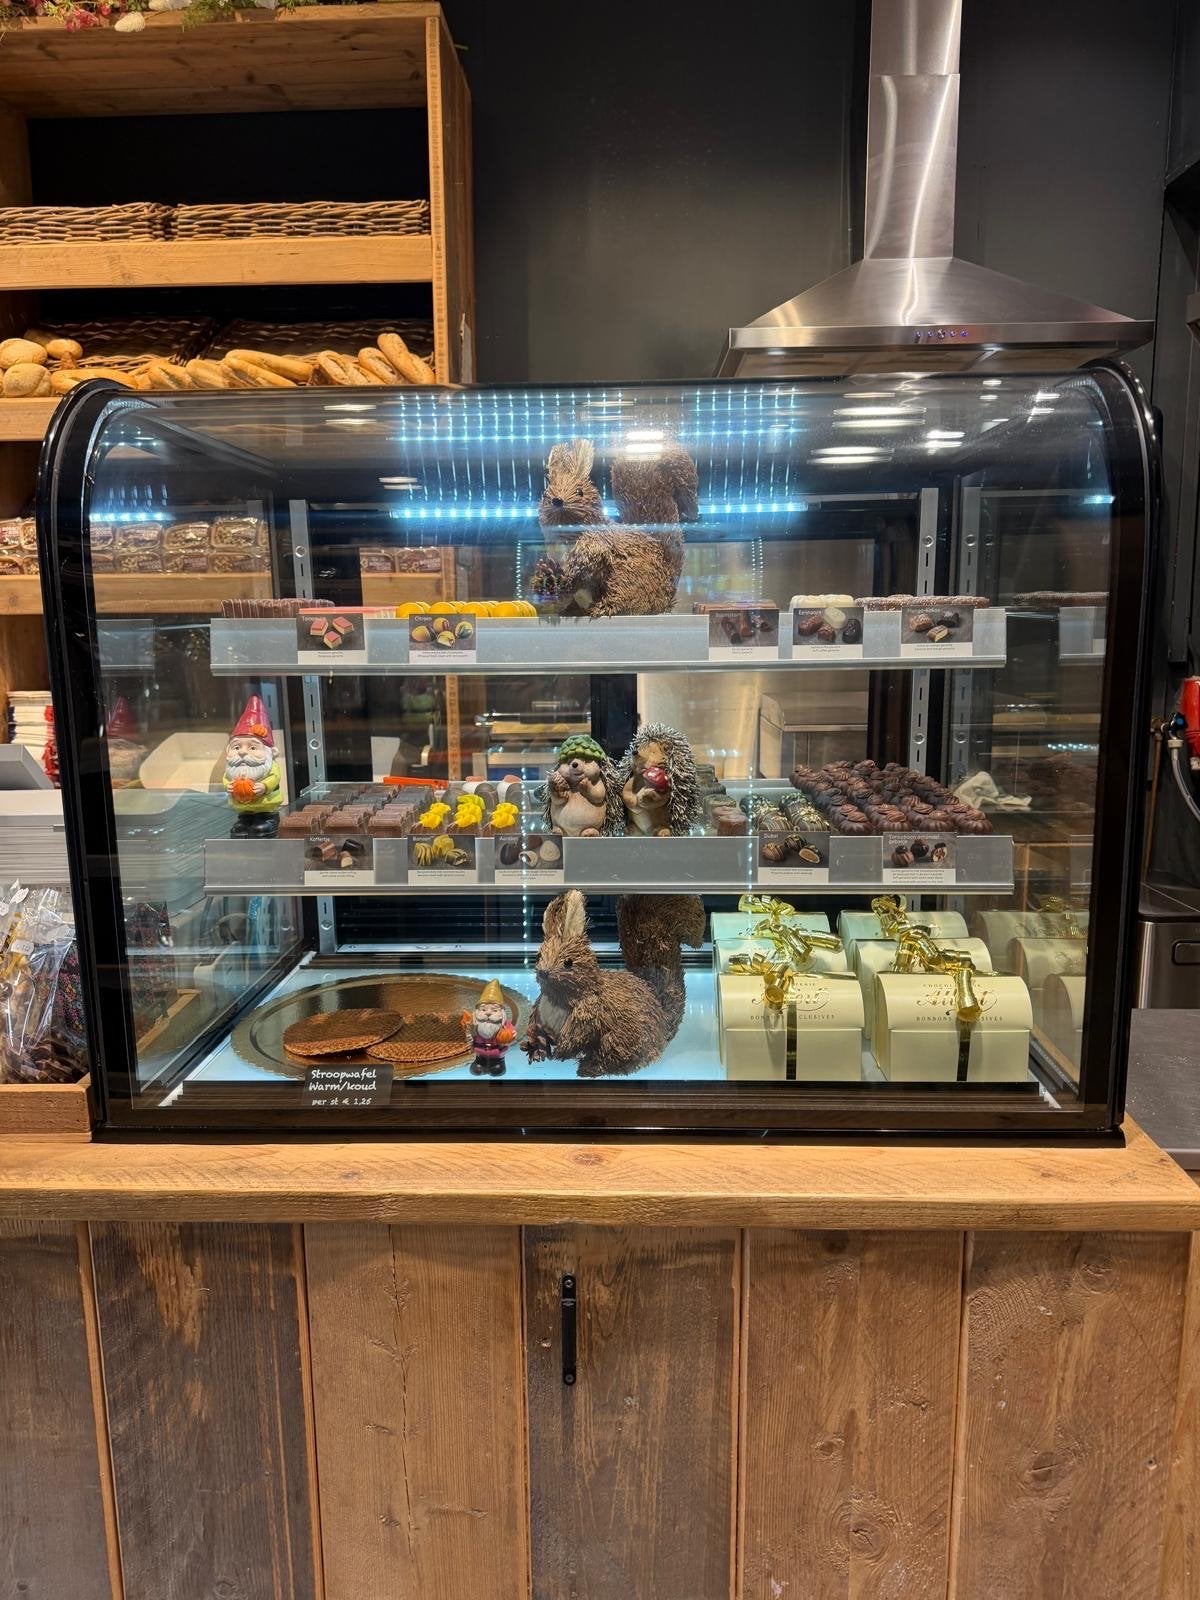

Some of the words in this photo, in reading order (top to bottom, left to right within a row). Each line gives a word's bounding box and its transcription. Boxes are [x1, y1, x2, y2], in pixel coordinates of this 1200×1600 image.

[311, 1067, 377, 1083] Stroopwafel
[308, 1080, 377, 1091] Warm/koud
[311, 1098, 327, 1106] per
[330, 1097, 339, 1105] st
[341, 1097, 350, 1105] €
